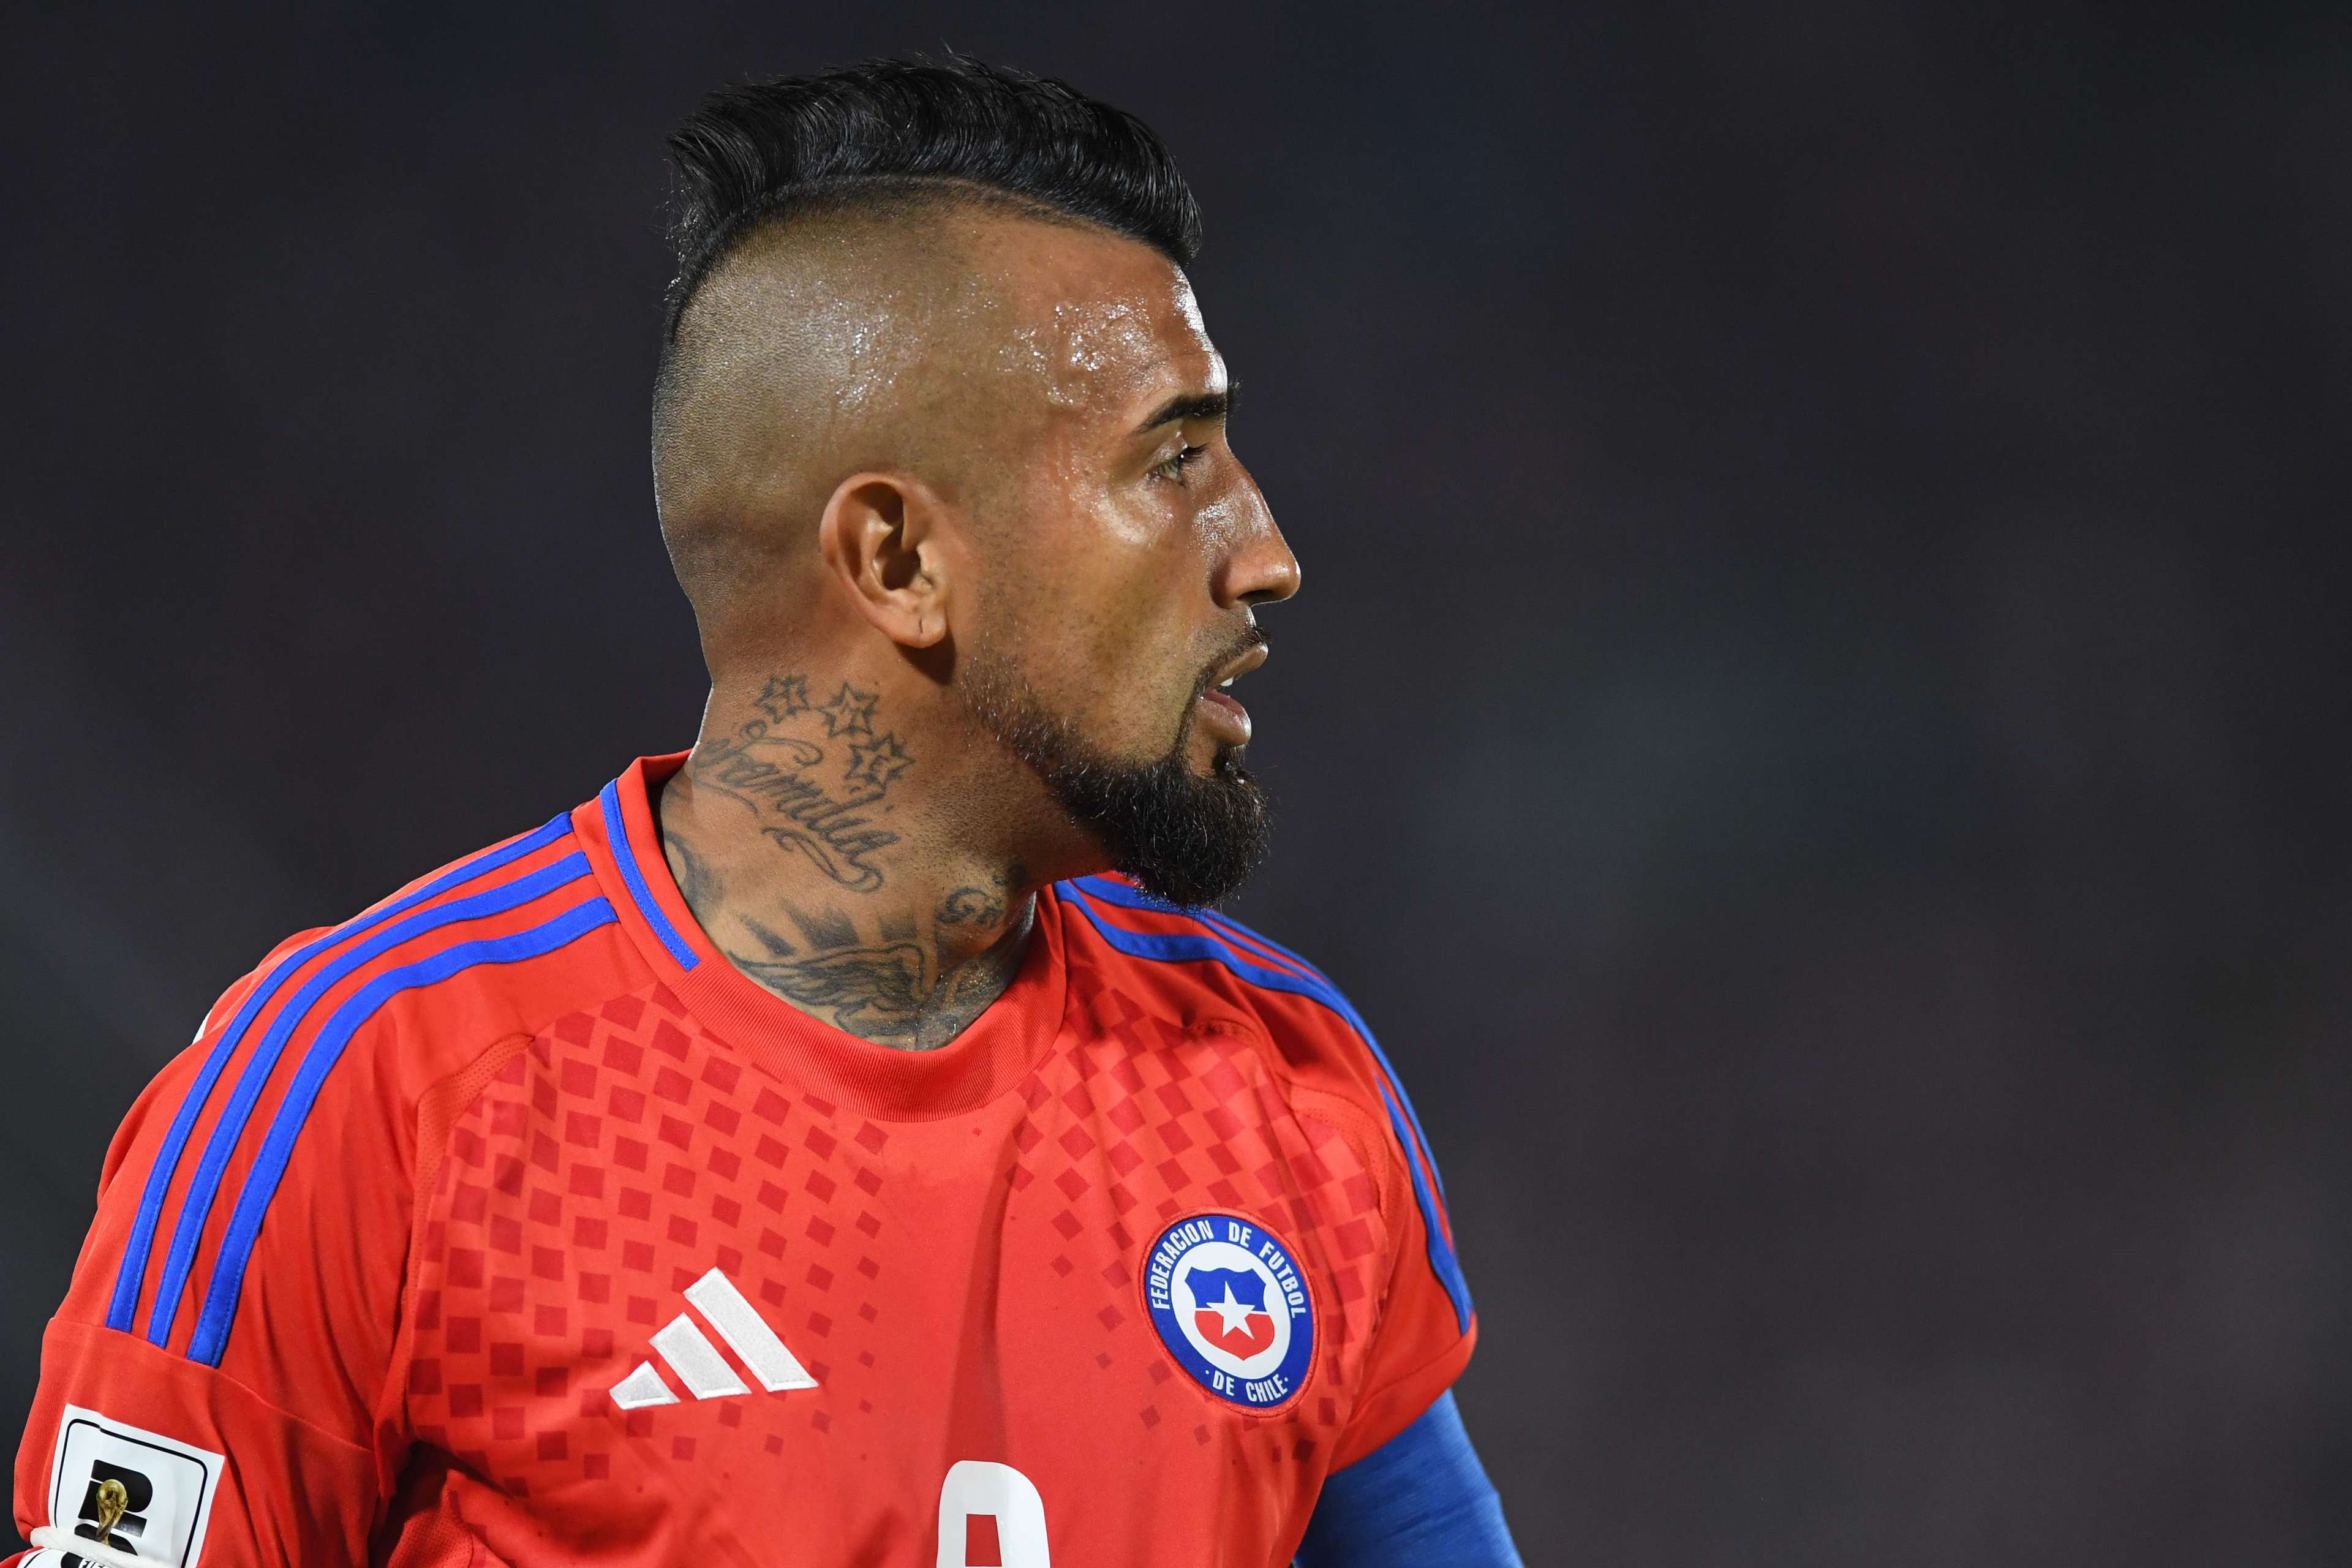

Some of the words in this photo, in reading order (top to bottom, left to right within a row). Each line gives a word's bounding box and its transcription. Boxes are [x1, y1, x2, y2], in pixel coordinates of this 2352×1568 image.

[1151, 1219, 1215, 1310] FEDERACION
[1228, 1221, 1253, 1248] DE
[1259, 1241, 1306, 1319] FUTBOL
[1212, 1370, 1235, 1396] DE
[1246, 1373, 1288, 1403] CHILE
